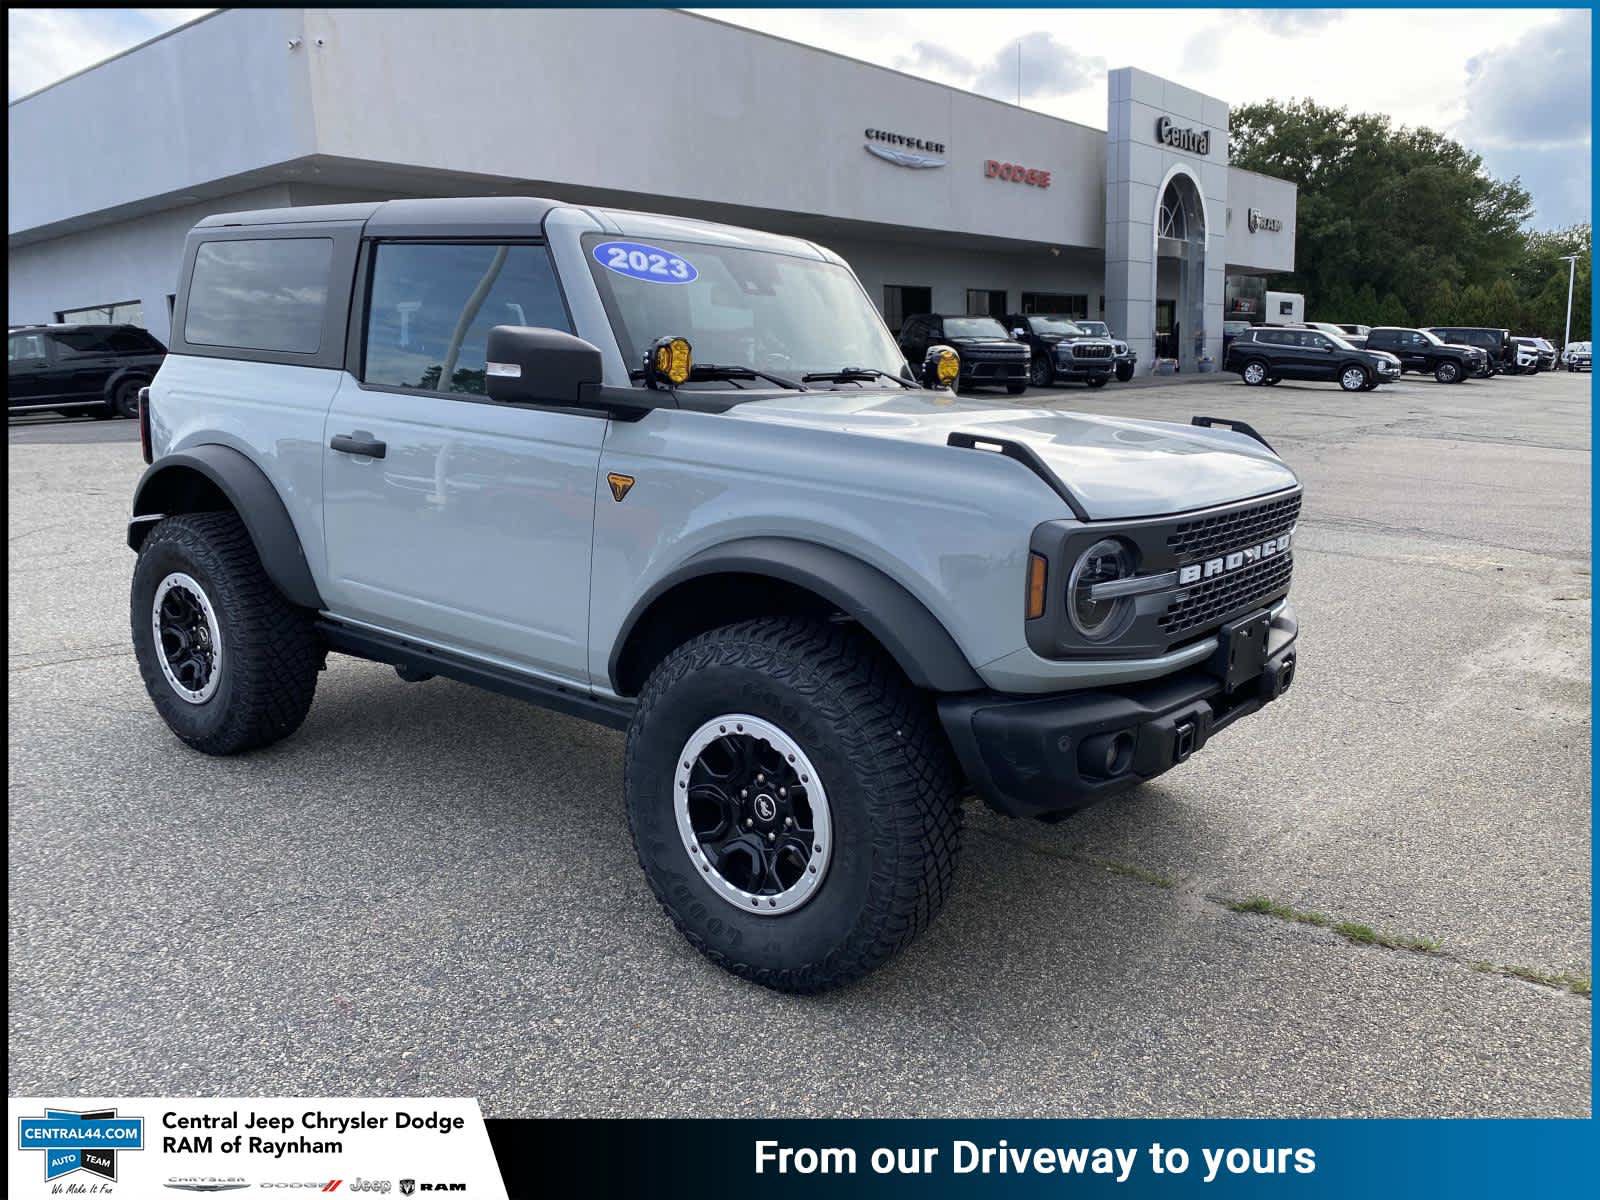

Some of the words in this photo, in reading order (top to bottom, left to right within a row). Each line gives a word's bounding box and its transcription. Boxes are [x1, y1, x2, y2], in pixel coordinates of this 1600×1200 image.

[864, 128, 946, 153] CHRYSLER
[1156, 116, 1210, 155] Central
[984, 159, 1051, 188] DODGE
[607, 247, 689, 279] 2023
[1179, 534, 1290, 585] BRONCO
